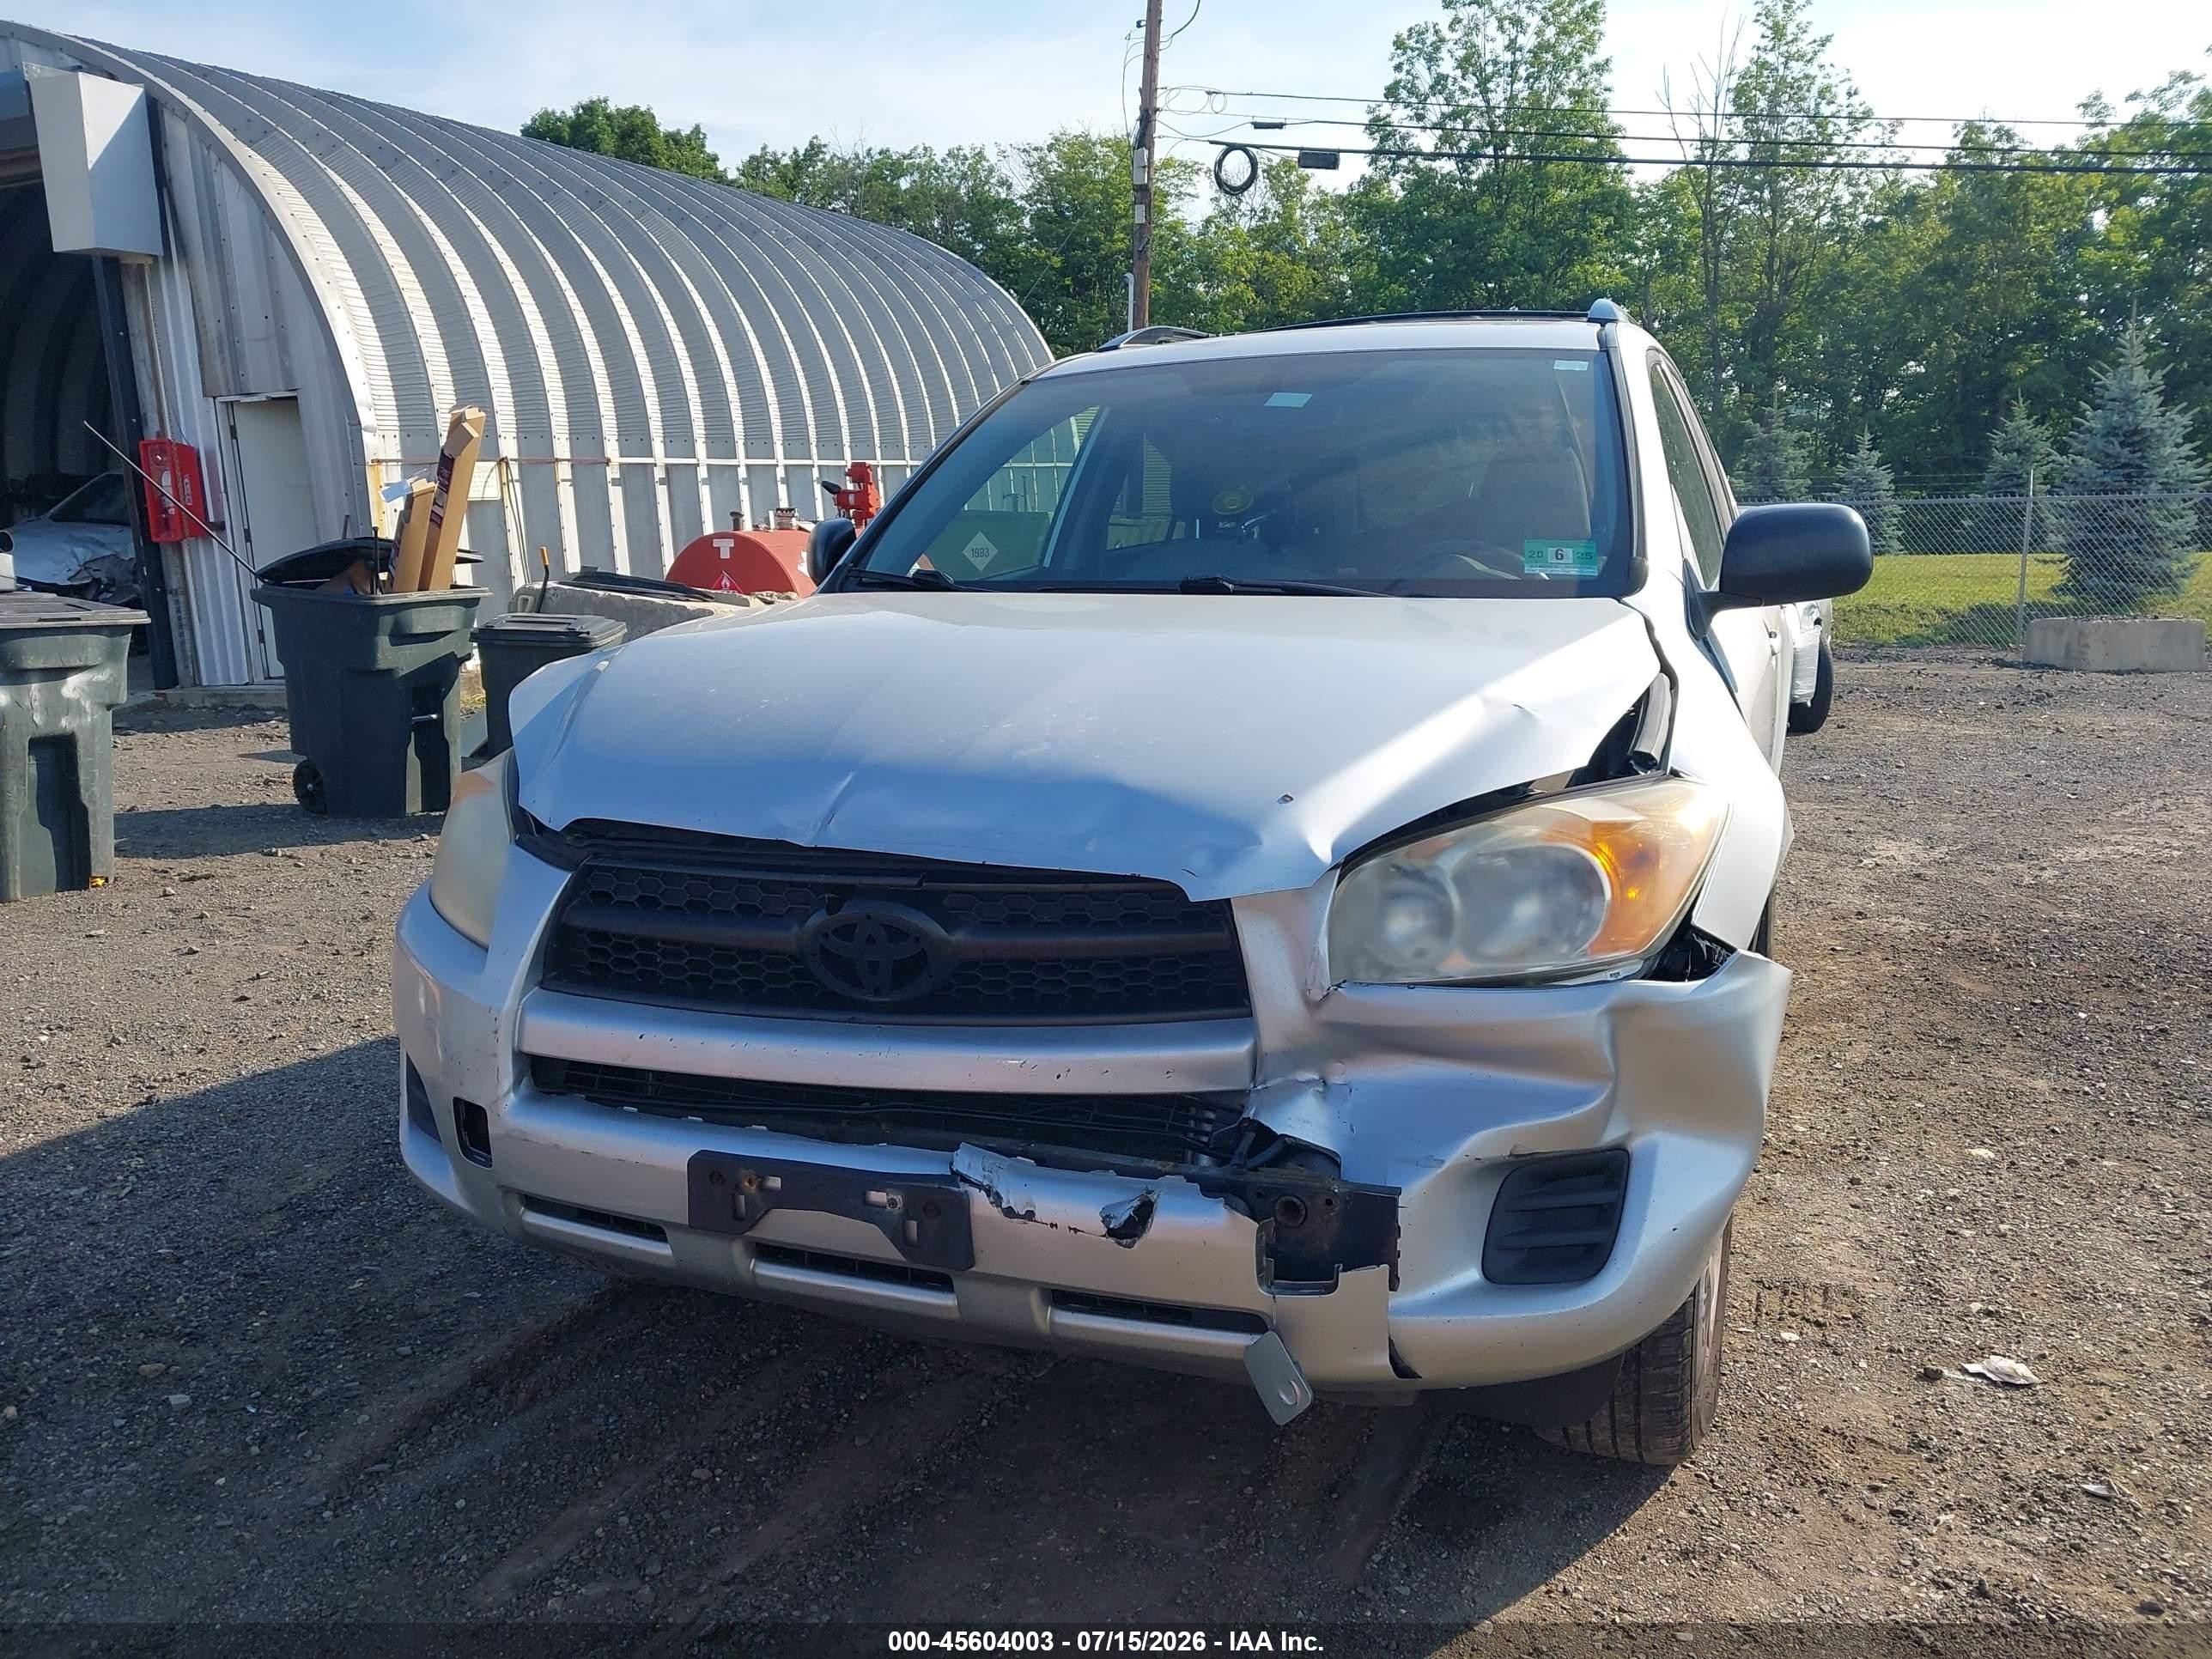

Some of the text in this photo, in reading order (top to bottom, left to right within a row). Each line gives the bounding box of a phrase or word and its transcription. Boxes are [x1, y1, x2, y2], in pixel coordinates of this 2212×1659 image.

[971, 547, 990, 558] 1993
[1554, 548, 1565, 561] 6
[1576, 551, 1593, 560] 25
